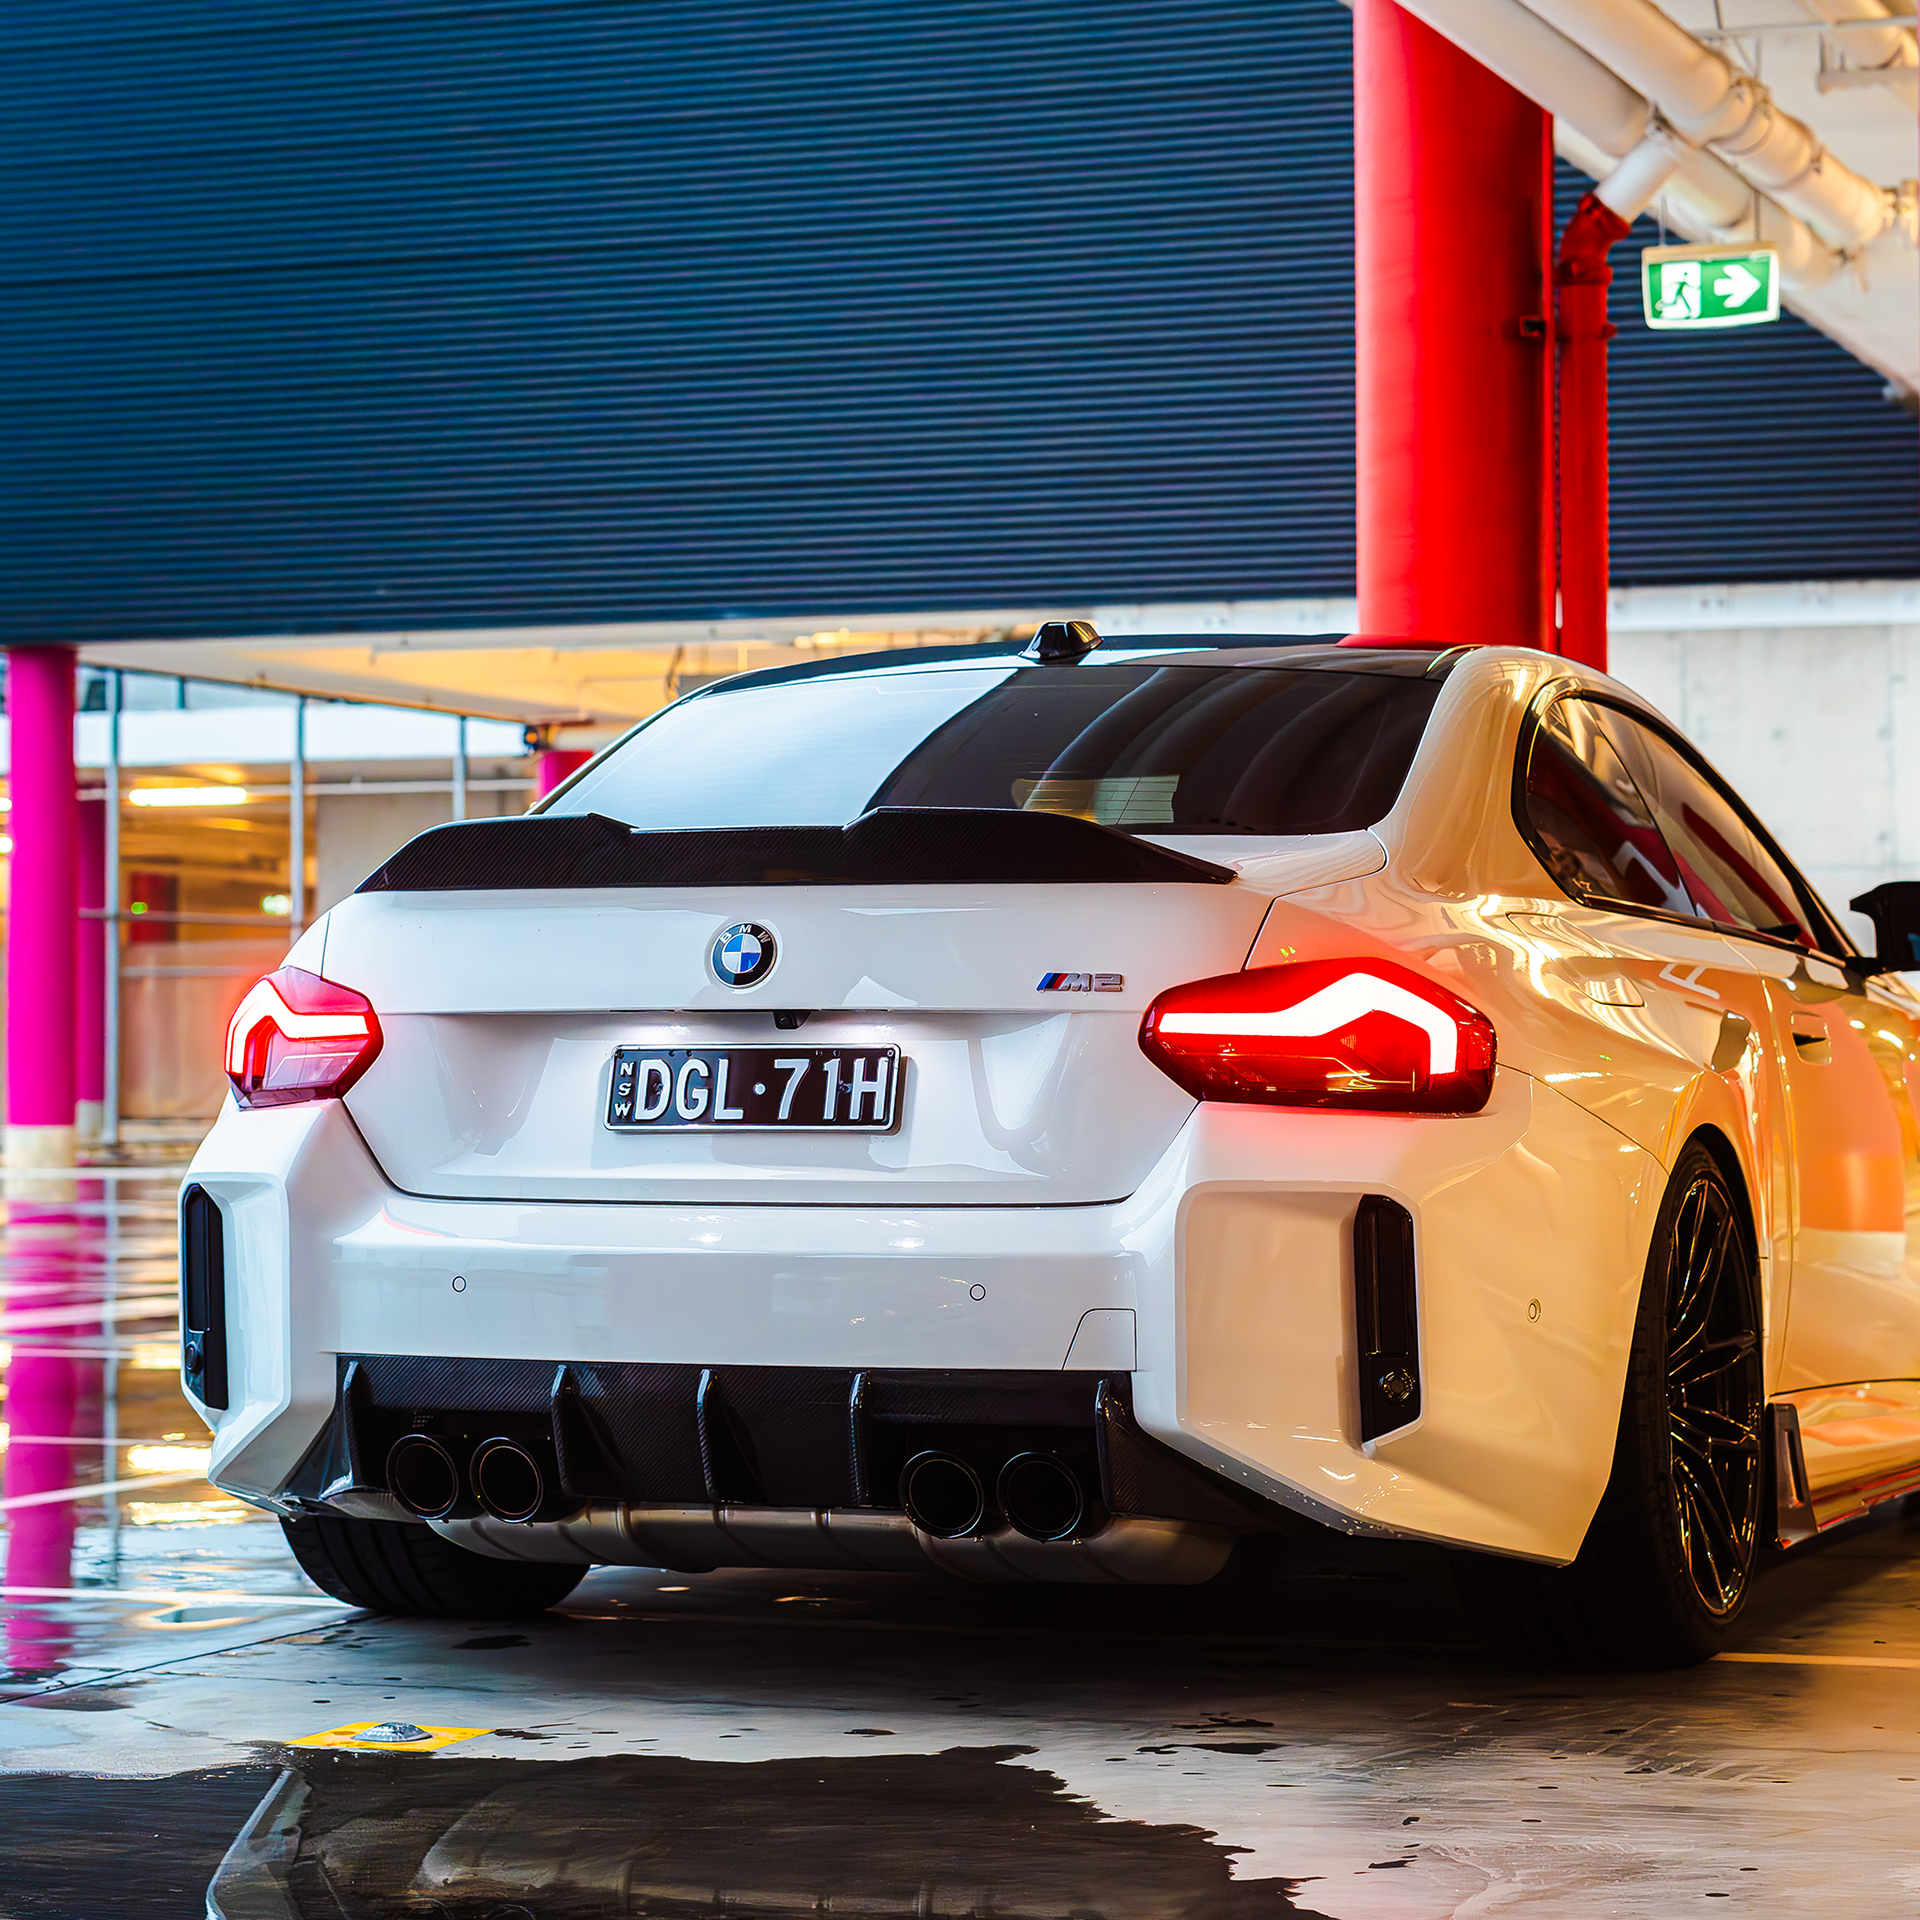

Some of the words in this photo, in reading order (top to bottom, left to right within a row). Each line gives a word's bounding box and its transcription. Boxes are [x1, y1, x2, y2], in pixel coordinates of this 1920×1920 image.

[719, 924, 771, 944] BMW
[1056, 972, 1123, 992] M2
[614, 1061, 634, 1118] NSW
